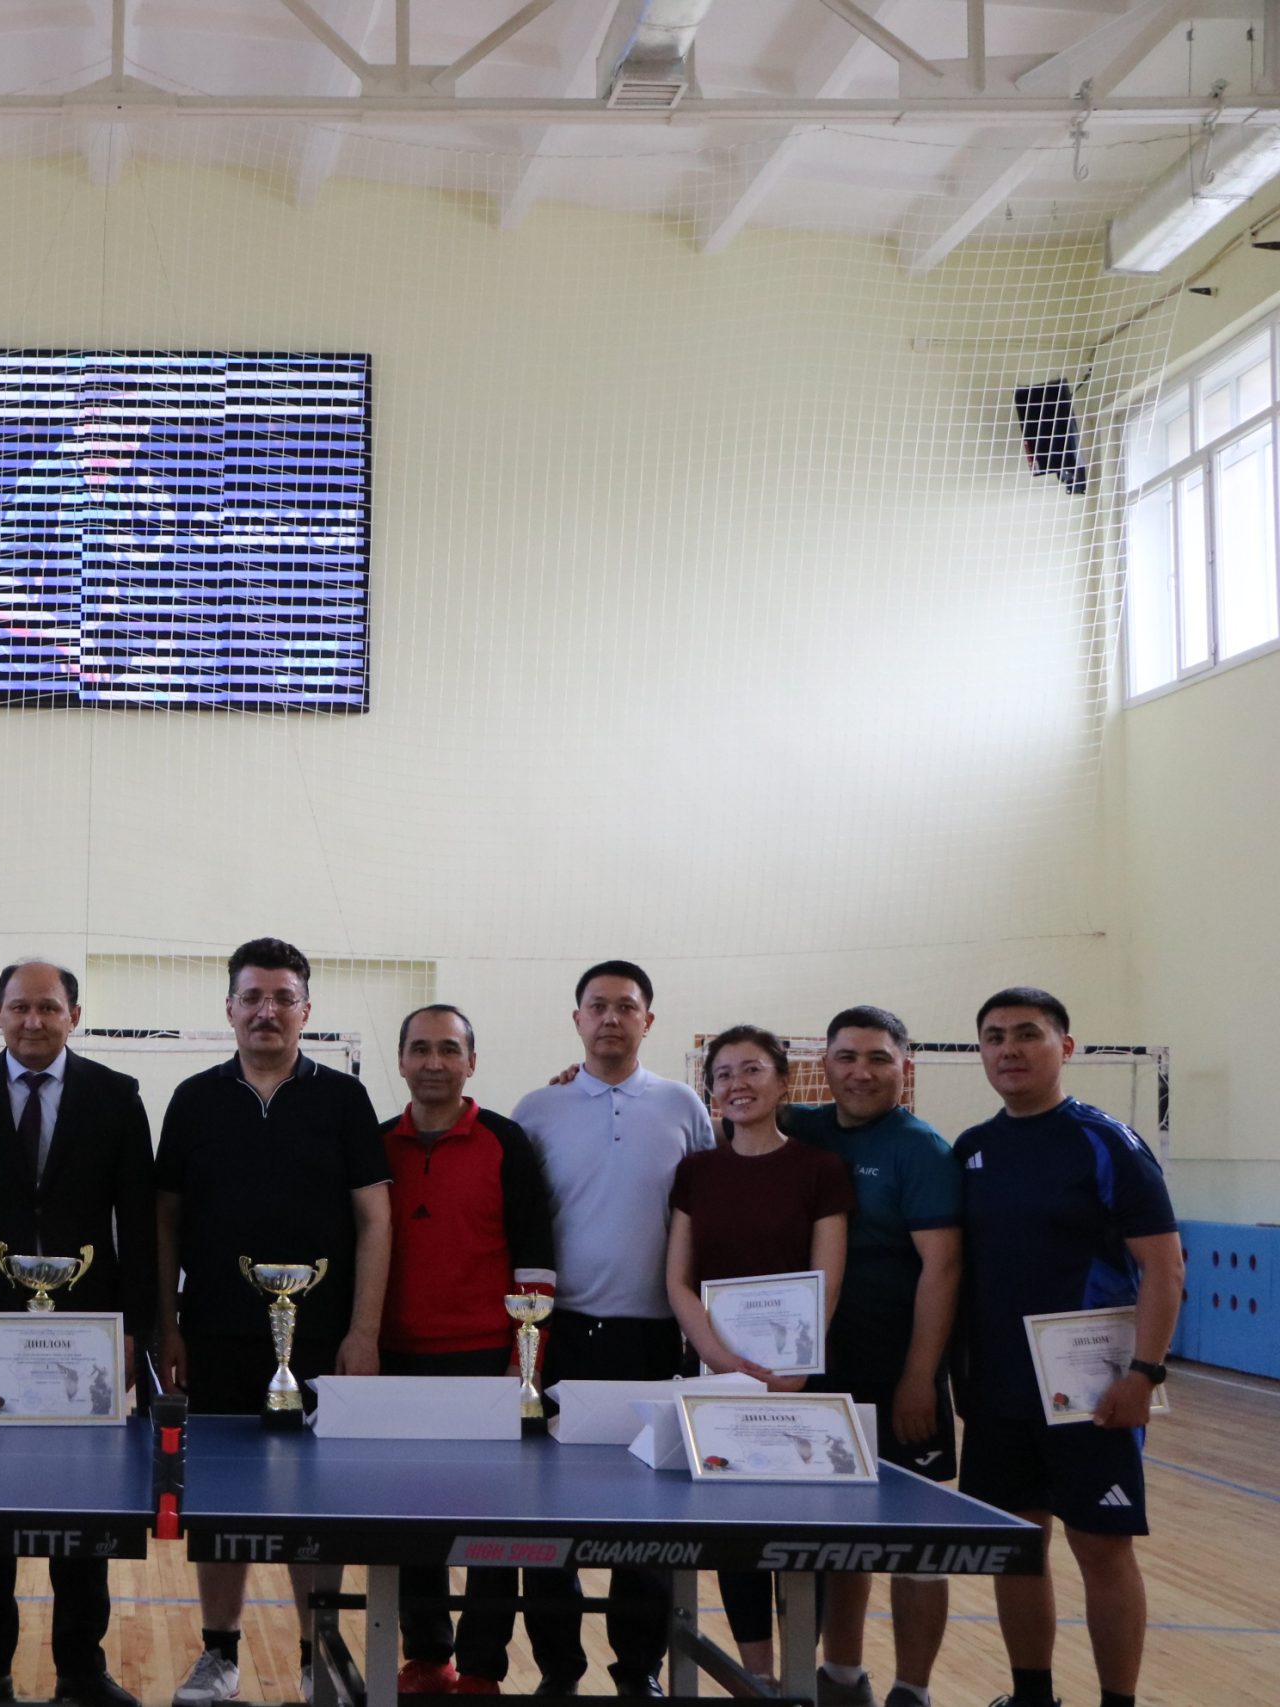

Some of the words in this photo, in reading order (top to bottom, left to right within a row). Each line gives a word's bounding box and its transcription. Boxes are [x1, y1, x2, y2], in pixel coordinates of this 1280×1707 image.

[24, 1339, 71, 1349] ДИПЛОМ
[14, 1529, 82, 1556] ITTF
[215, 1534, 284, 1560] ITTF
[464, 1542, 504, 1560] HIGH
[507, 1543, 557, 1562] SPEED
[574, 1540, 703, 1564] CHAMPION
[756, 1541, 913, 1571] START
[916, 1544, 1012, 1573] LINE
